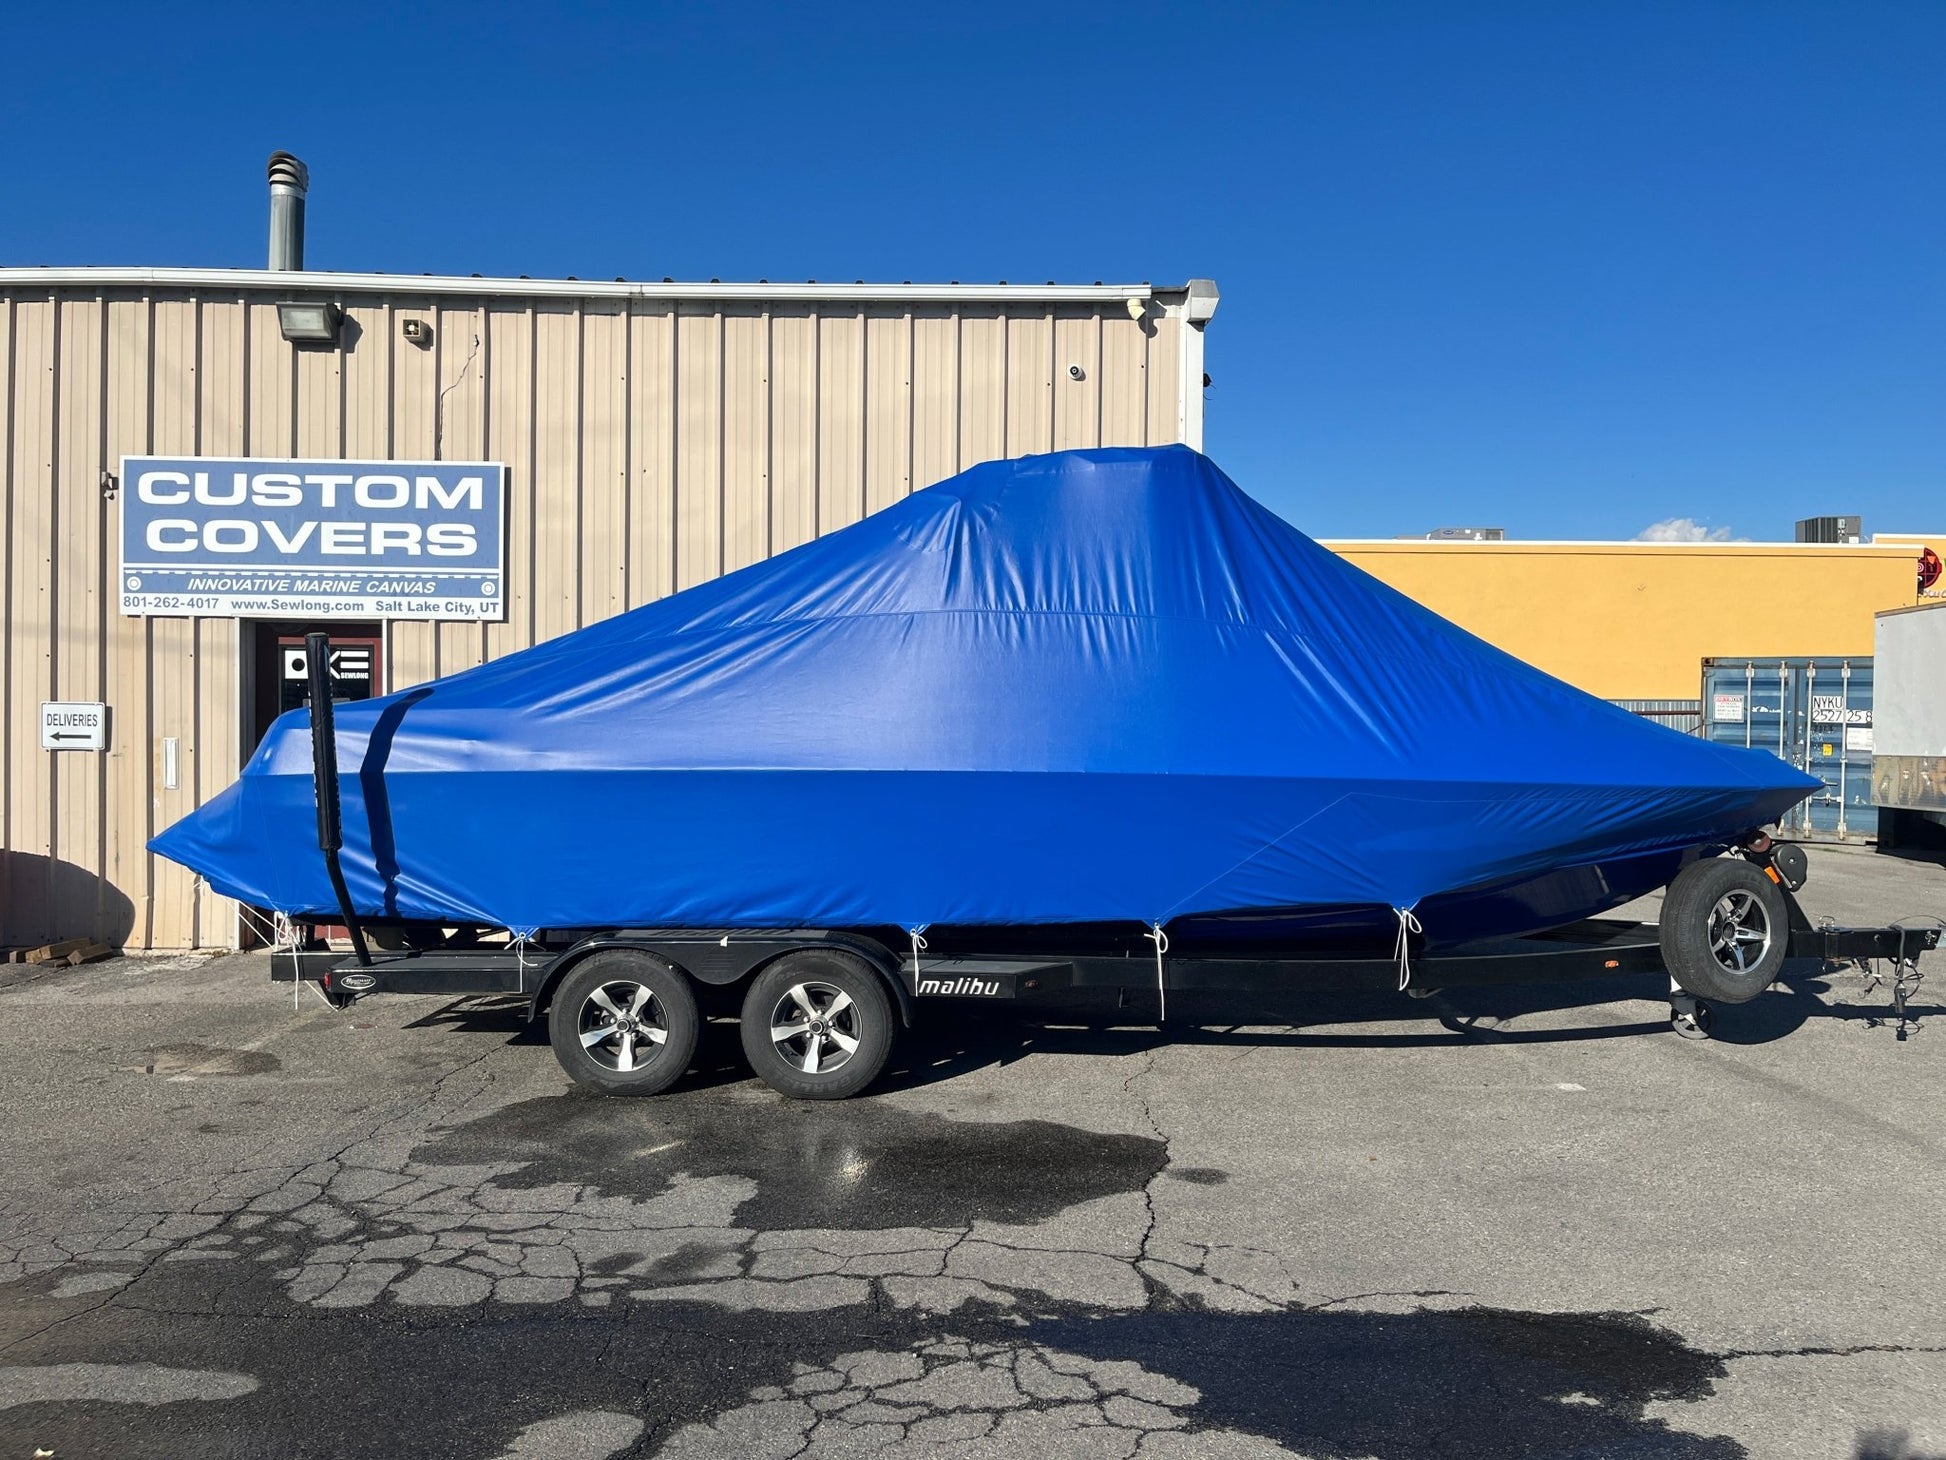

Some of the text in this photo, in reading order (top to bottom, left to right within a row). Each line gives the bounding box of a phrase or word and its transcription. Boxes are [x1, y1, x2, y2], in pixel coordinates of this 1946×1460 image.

[138, 471, 484, 511] CUSTOM
[145, 518, 478, 556] COVERS
[187, 578, 436, 594] INNOVATIVE MARINE CANVAS
[123, 596, 499, 615] 801-262-4017 www.Sewlong.com Salt Lake City, UT
[1813, 697, 1842, 709] NYKU
[46, 713, 98, 727] DELIVERIES
[919, 977, 1000, 996] malibu
